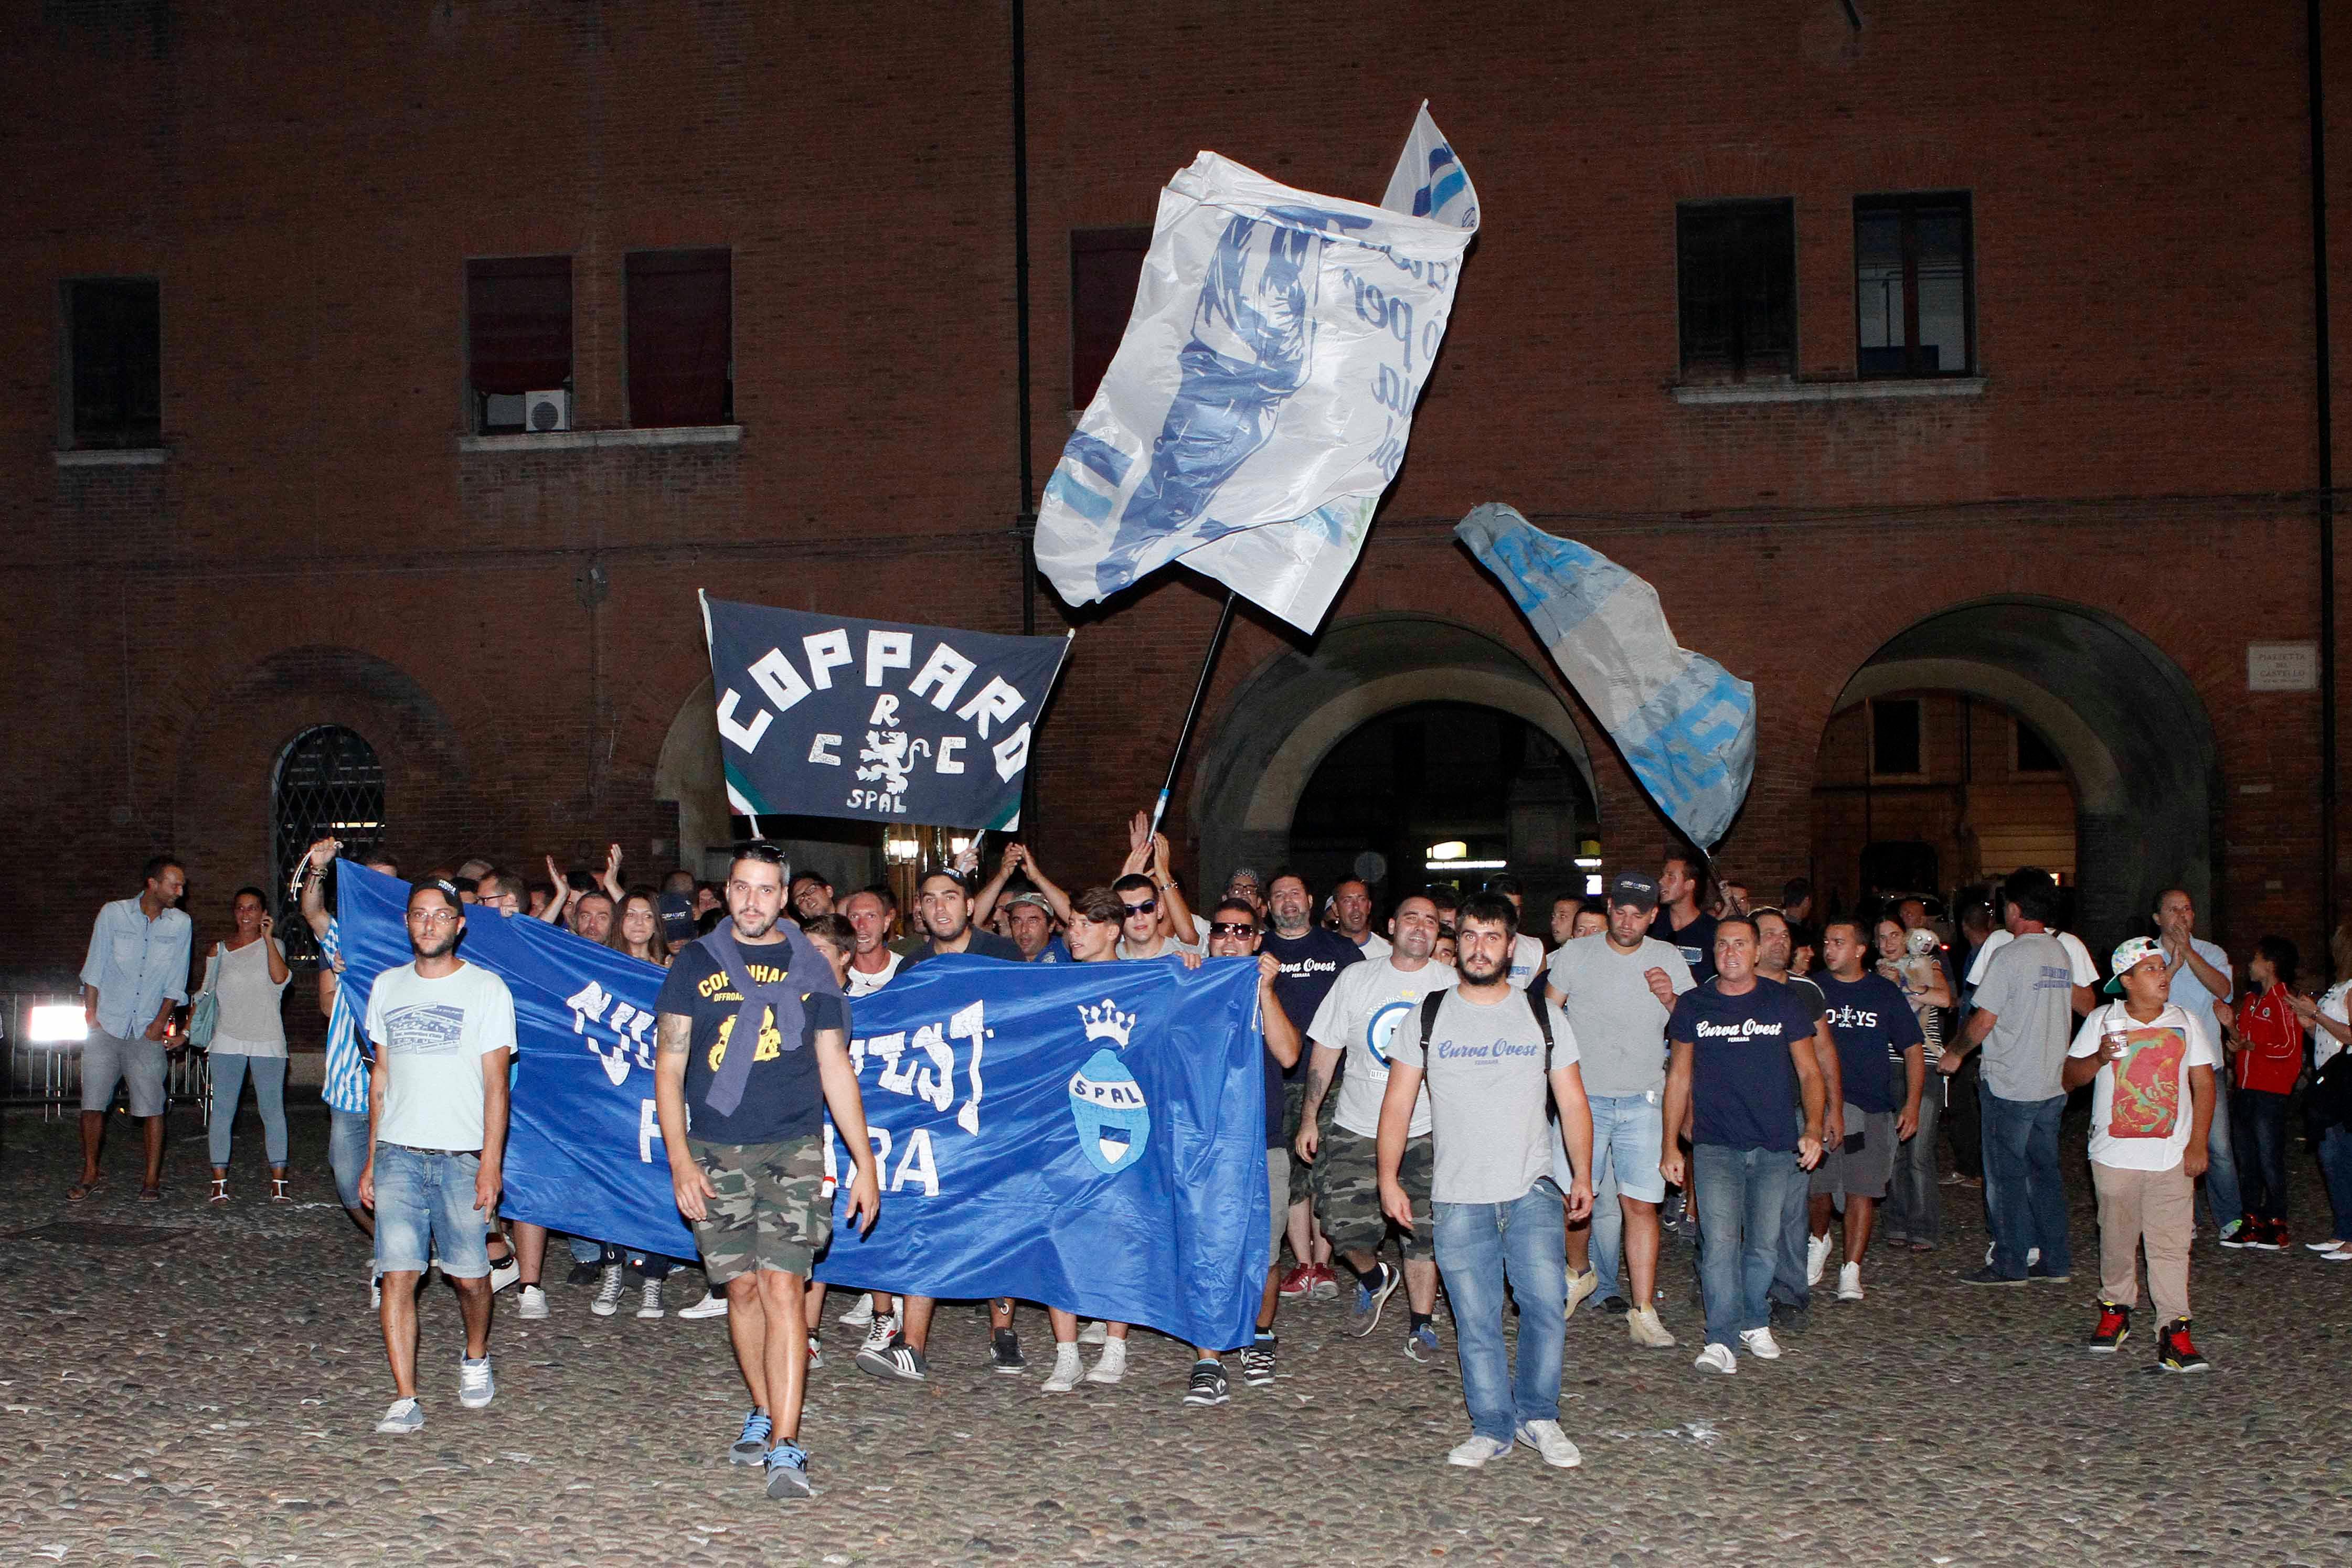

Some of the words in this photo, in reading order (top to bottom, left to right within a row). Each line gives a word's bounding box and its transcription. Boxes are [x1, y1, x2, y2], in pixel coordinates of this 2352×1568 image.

[717, 628, 1031, 784] COPPARO
[869, 694, 900, 727] R
[808, 733, 842, 766] C
[936, 737, 966, 774] C
[846, 788, 907, 814] SPAL
[1279, 962, 1302, 973] rva
[1303, 958, 1336, 972] Ovest
[1696, 1020, 1740, 1038] Curva
[1742, 1018, 1783, 1036] Ovest
[1438, 1040, 1488, 1059] Curva
[1492, 1038, 1538, 1057] Ovest
[1074, 1080, 1141, 1104] SPAL
